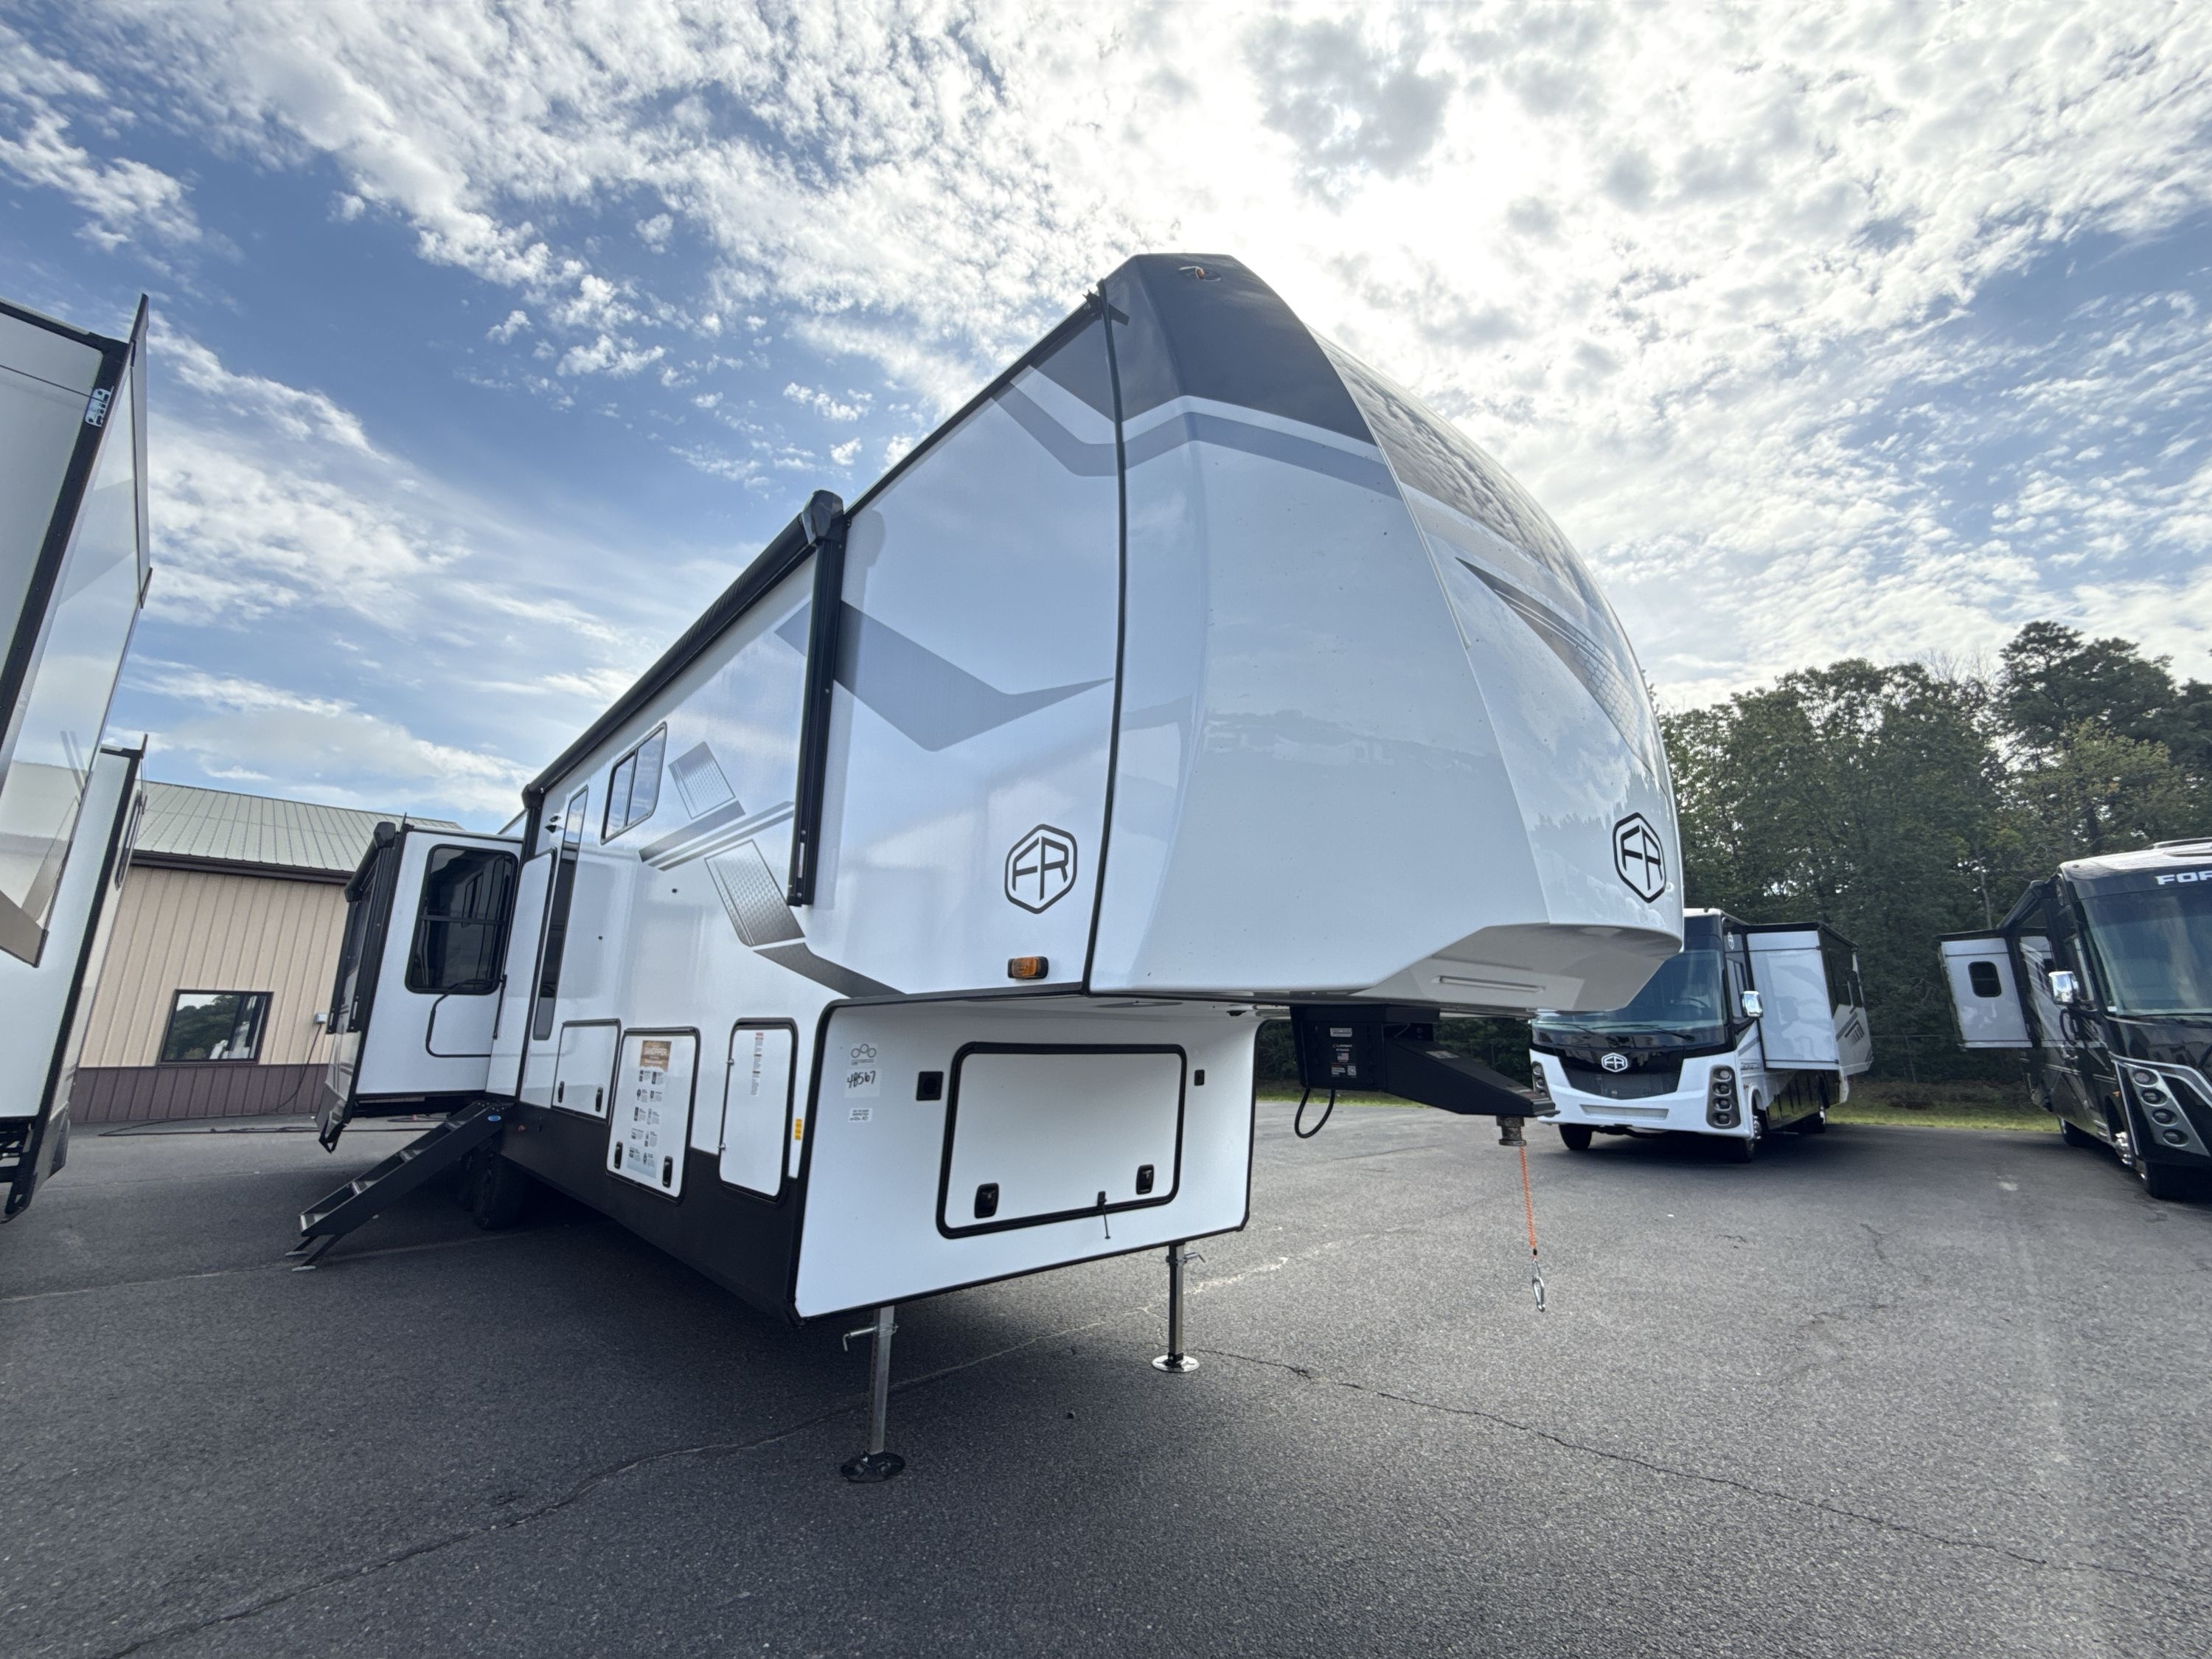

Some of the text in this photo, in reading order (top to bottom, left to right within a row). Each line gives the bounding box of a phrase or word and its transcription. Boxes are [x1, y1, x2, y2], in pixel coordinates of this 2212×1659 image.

[1012, 836, 1069, 901] FR
[1621, 824, 1663, 891] FR
[1604, 1055, 1625, 1070] FR
